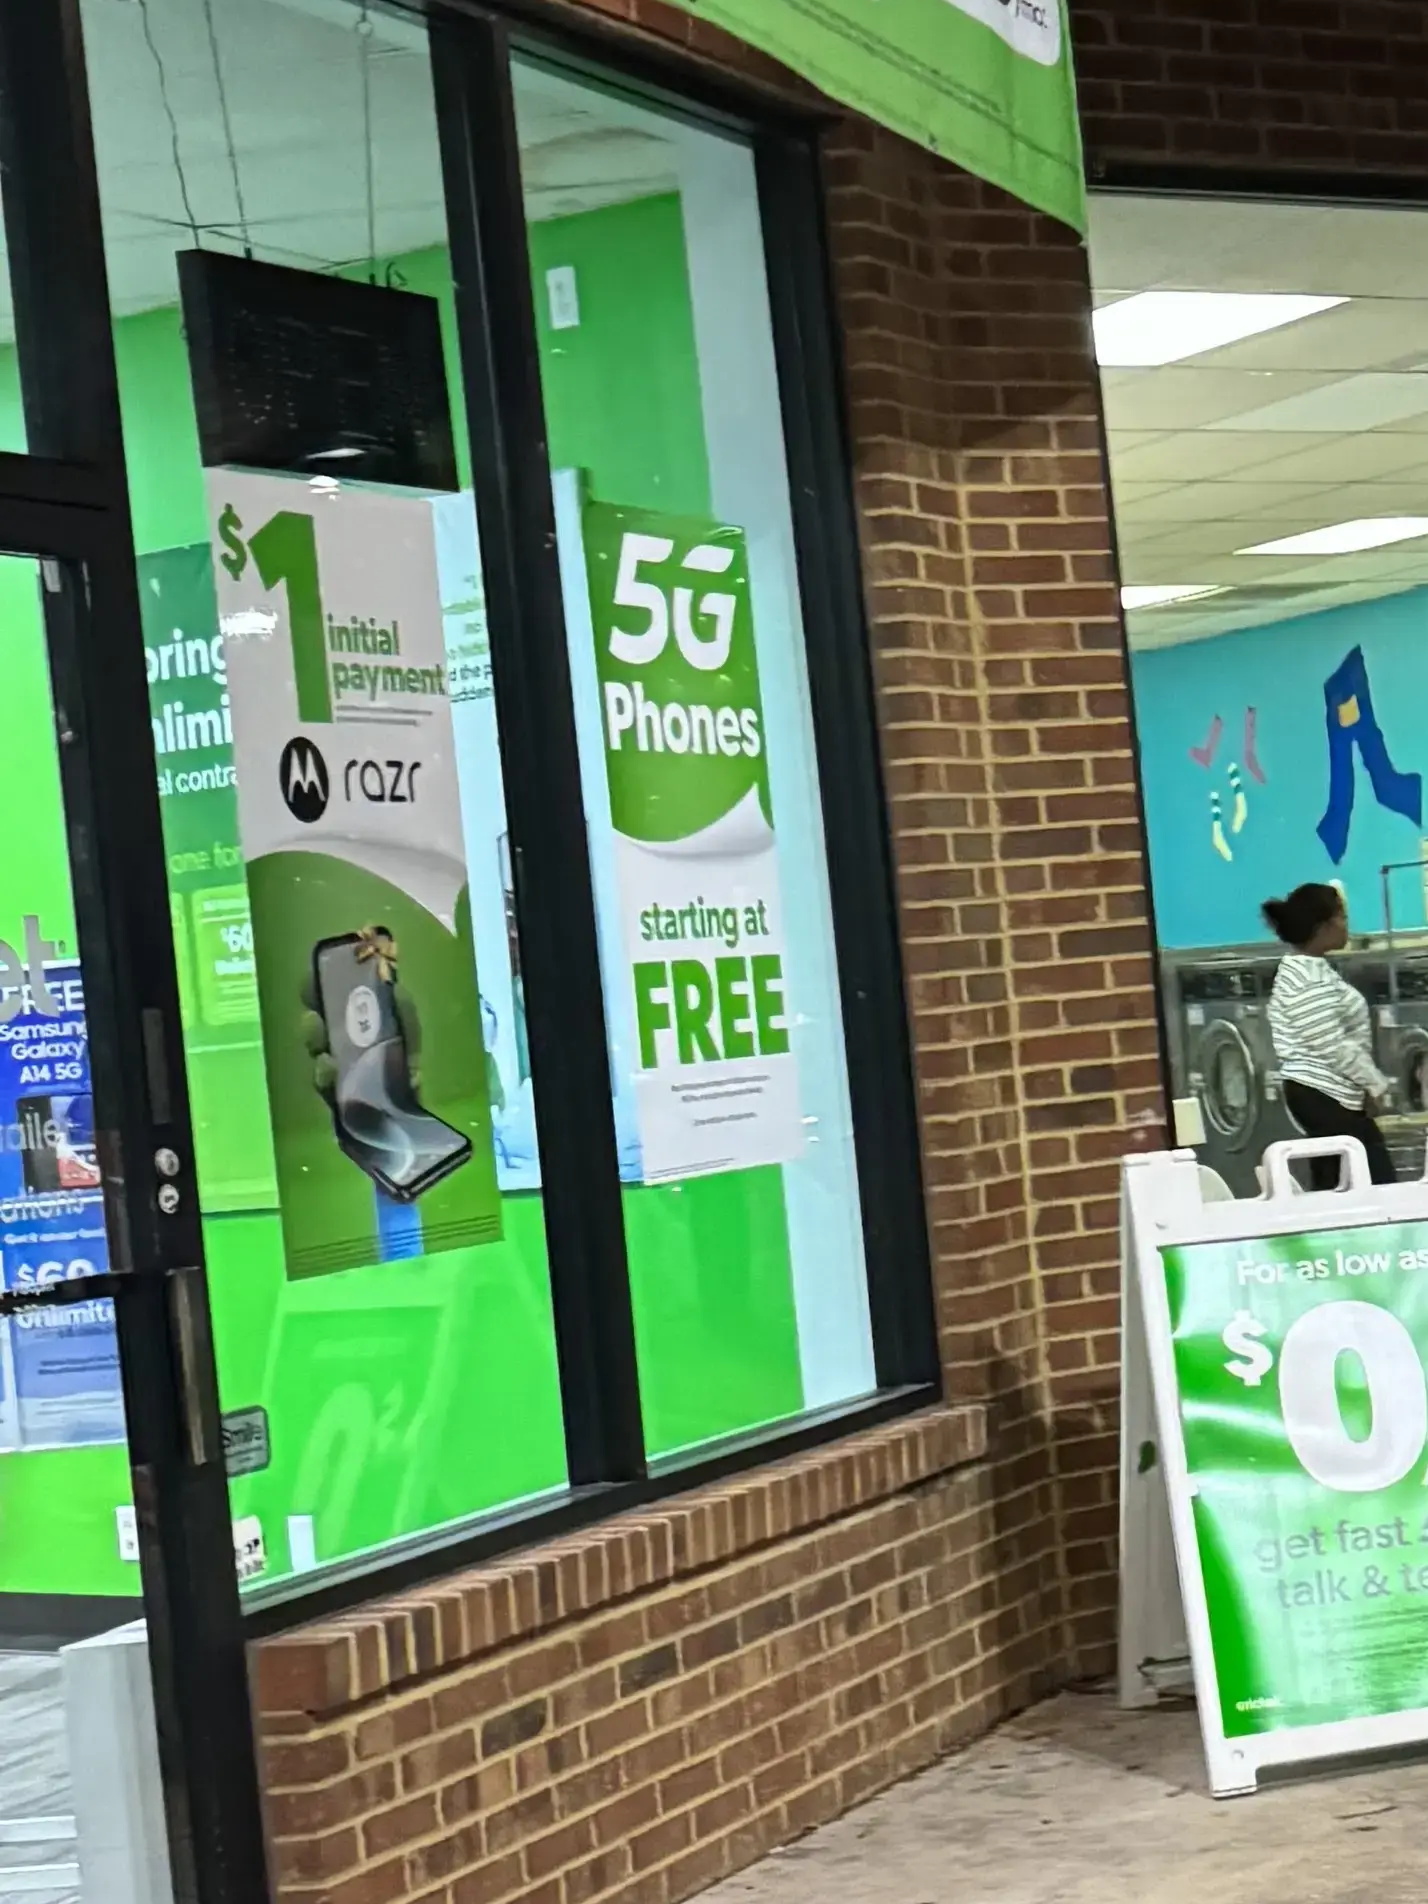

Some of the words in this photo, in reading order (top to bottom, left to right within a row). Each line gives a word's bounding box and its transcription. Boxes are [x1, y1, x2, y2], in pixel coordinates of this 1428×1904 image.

[218, 503, 334, 724] $1
[609, 532, 737, 671] 5G
[328, 613, 400, 656] initial
[332, 661, 450, 701] payment
[606, 680, 761, 759] Phones
[344, 759, 422, 803] razr
[640, 894, 740, 949] starting
[742, 896, 768, 938] at
[633, 953, 791, 1071] FREE
[11, 1038, 86, 1061] Galaxy
[20, 1065, 51, 1085] A14
[54, 1062, 83, 1081] 5G
[1236, 1259, 1290, 1287] For
[1296, 1257, 1330, 1280] as
[1335, 1249, 1392, 1277] low
[1221, 1299, 1428, 1493] $0
[1252, 1525, 1328, 1573] get
[1335, 1515, 1413, 1554] fast
[1276, 1568, 1352, 1609] talk
[1361, 1564, 1391, 1598] &
